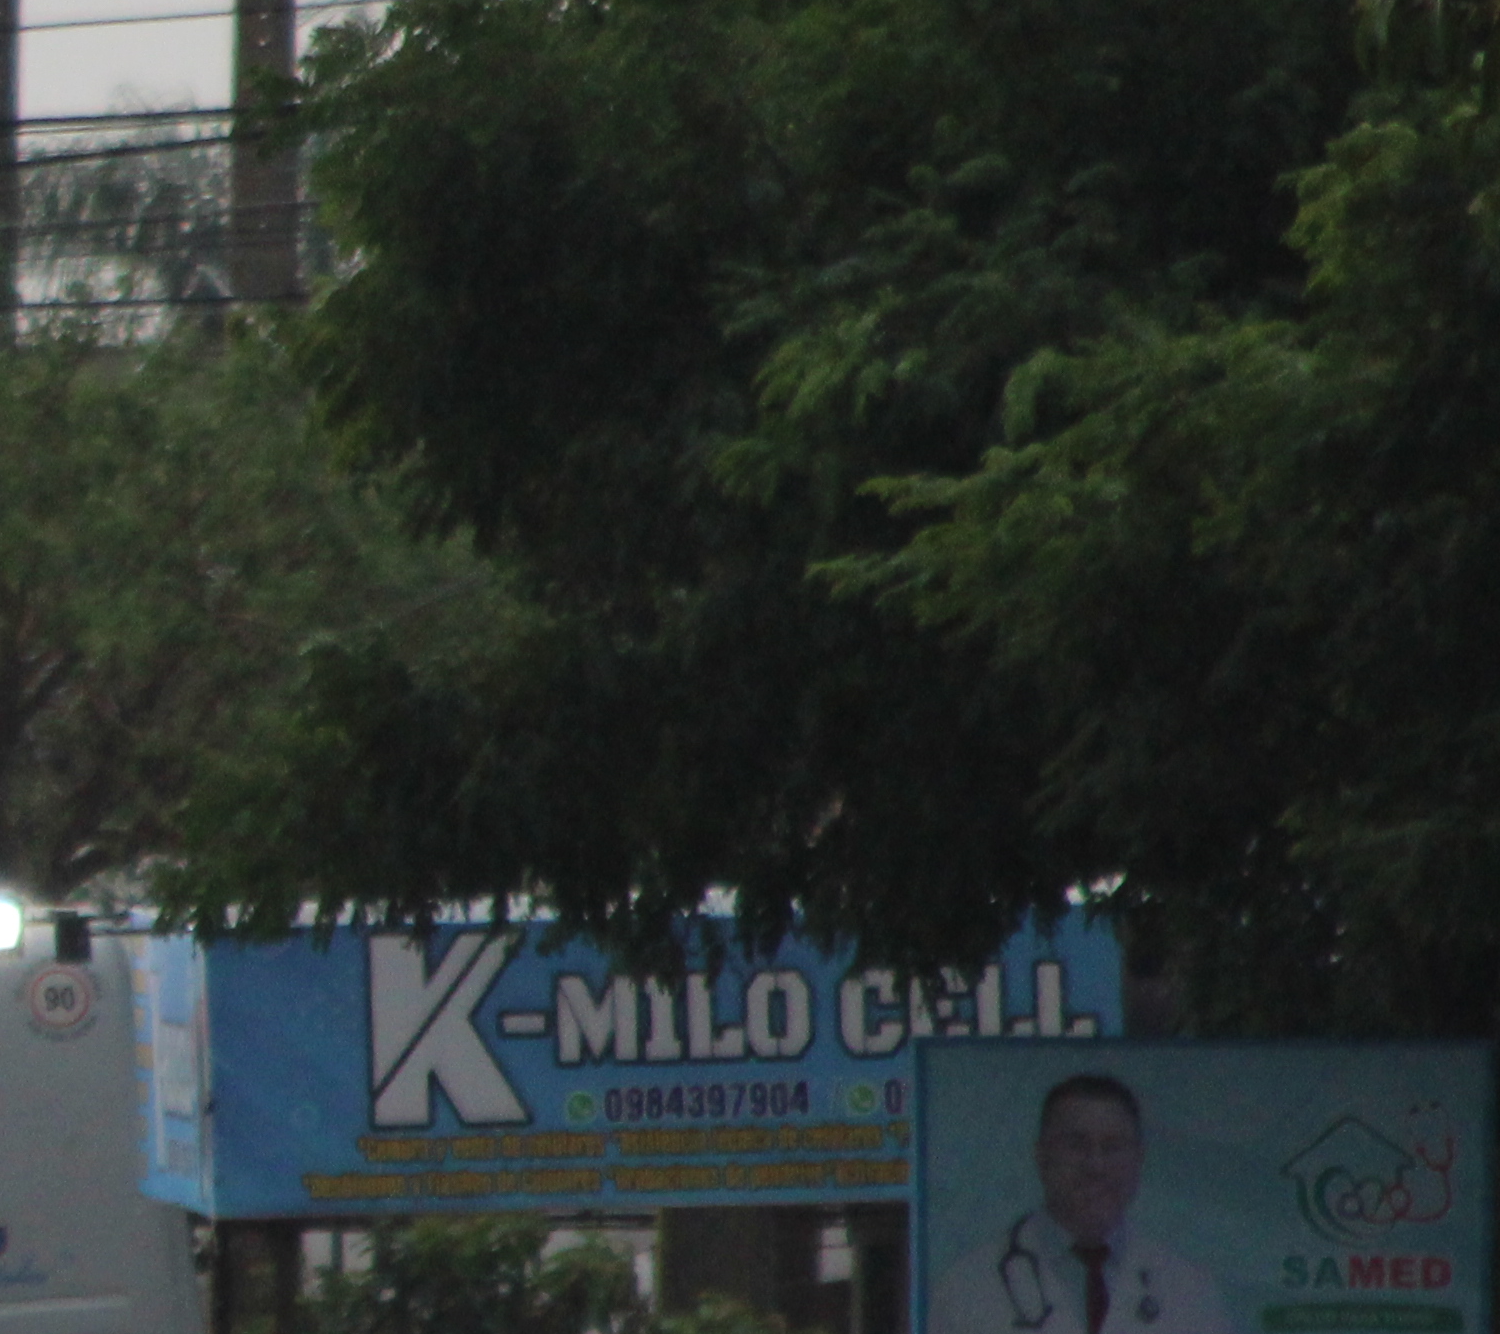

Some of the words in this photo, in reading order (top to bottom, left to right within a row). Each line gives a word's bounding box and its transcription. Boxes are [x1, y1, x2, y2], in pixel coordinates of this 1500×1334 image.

[44, 985, 76, 1013] 90
[368, 933, 812, 1127] K-MILO
[604, 1080, 809, 1122] 0984397904
[1281, 1254, 1452, 1289] SAMED
